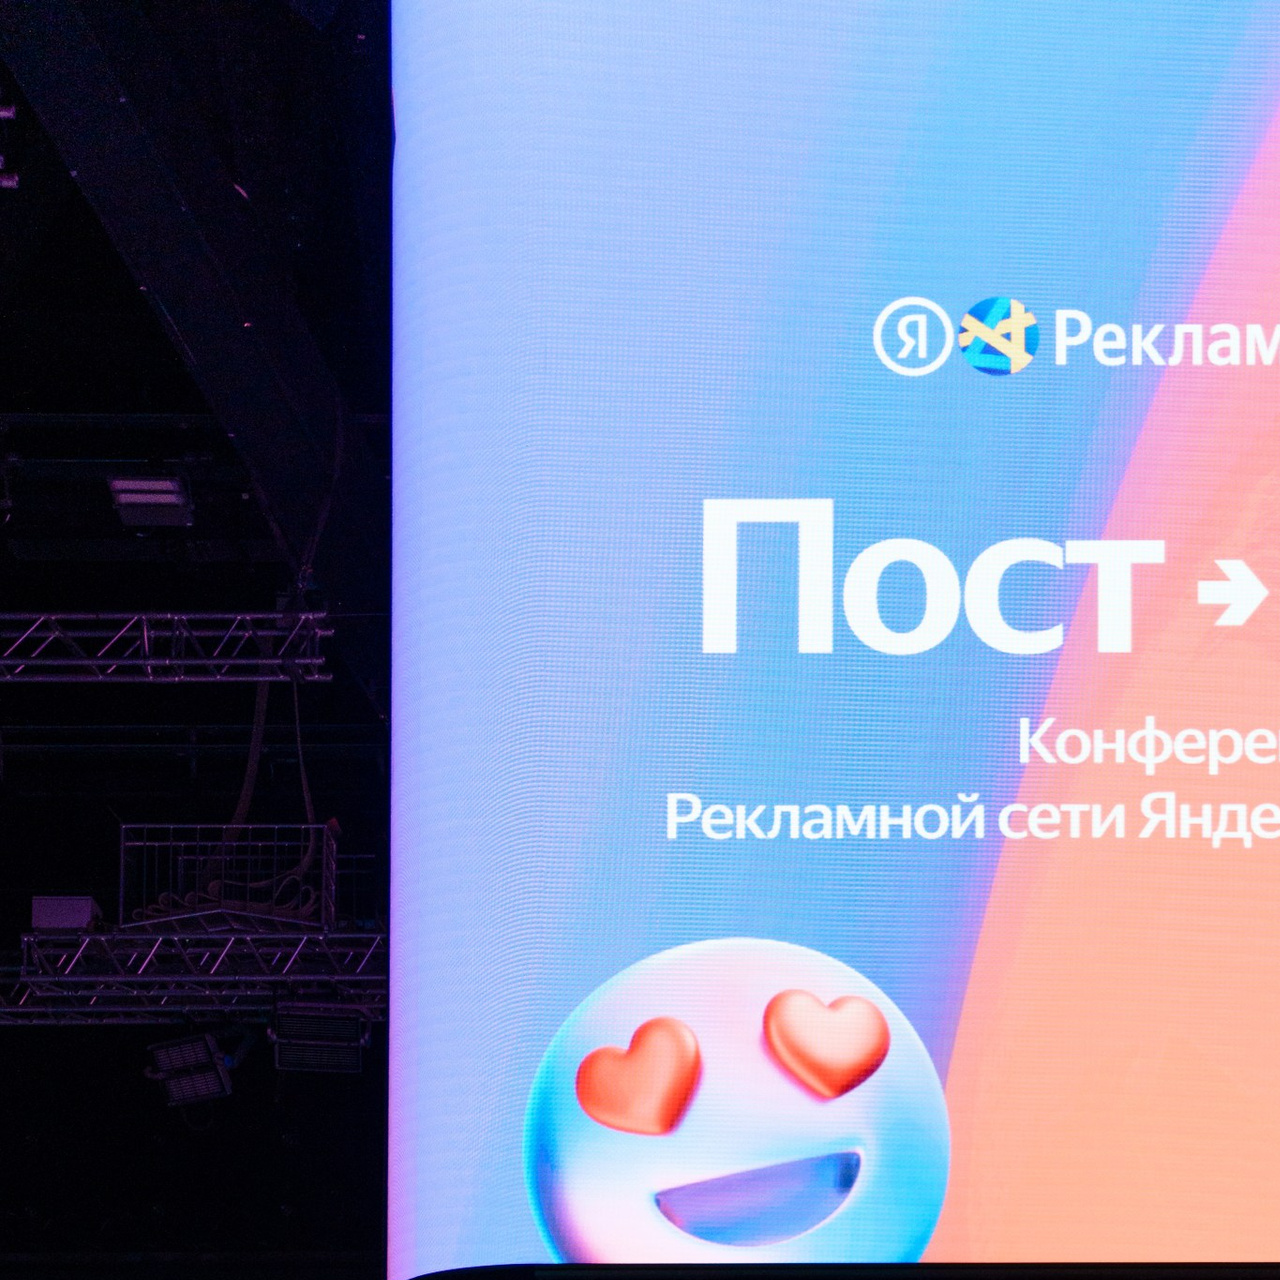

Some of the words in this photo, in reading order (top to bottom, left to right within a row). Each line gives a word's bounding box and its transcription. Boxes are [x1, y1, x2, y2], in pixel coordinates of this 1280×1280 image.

[702, 498, 1166, 655] Пост
[666, 792, 985, 840] Рекламной
[998, 803, 1126, 840] сети
